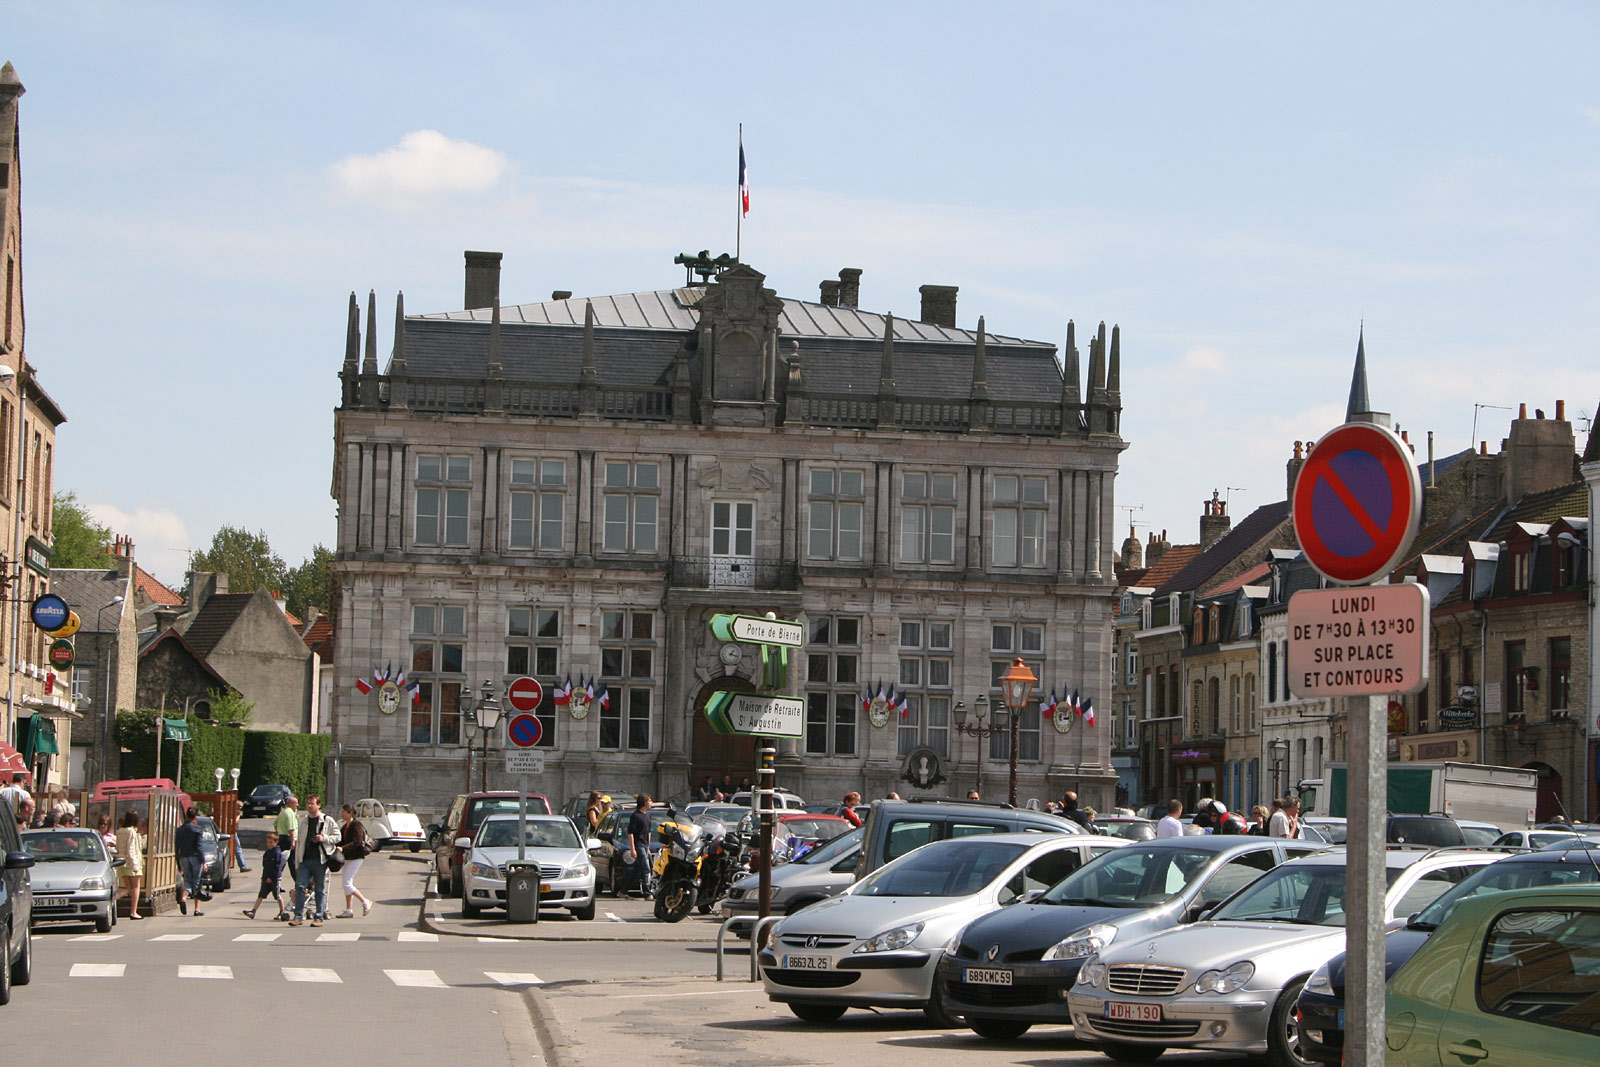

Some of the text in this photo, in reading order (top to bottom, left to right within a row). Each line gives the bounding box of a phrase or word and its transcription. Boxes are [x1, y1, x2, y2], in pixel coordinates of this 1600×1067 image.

[36, 606, 64, 614] LAVAZZA
[1332, 596, 1375, 614] LUNDI
[746, 624, 800, 641] Porte de Bierne
[1294, 618, 1414, 640] DE 7H30 À 13H30
[1314, 643, 1393, 663] SUR PLACE
[1304, 668, 1403, 687] ET CONTOURS
[739, 700, 800, 716] Maison de Retraite
[749, 716, 782, 731] Augustin
[817, 958, 827, 969] 25
